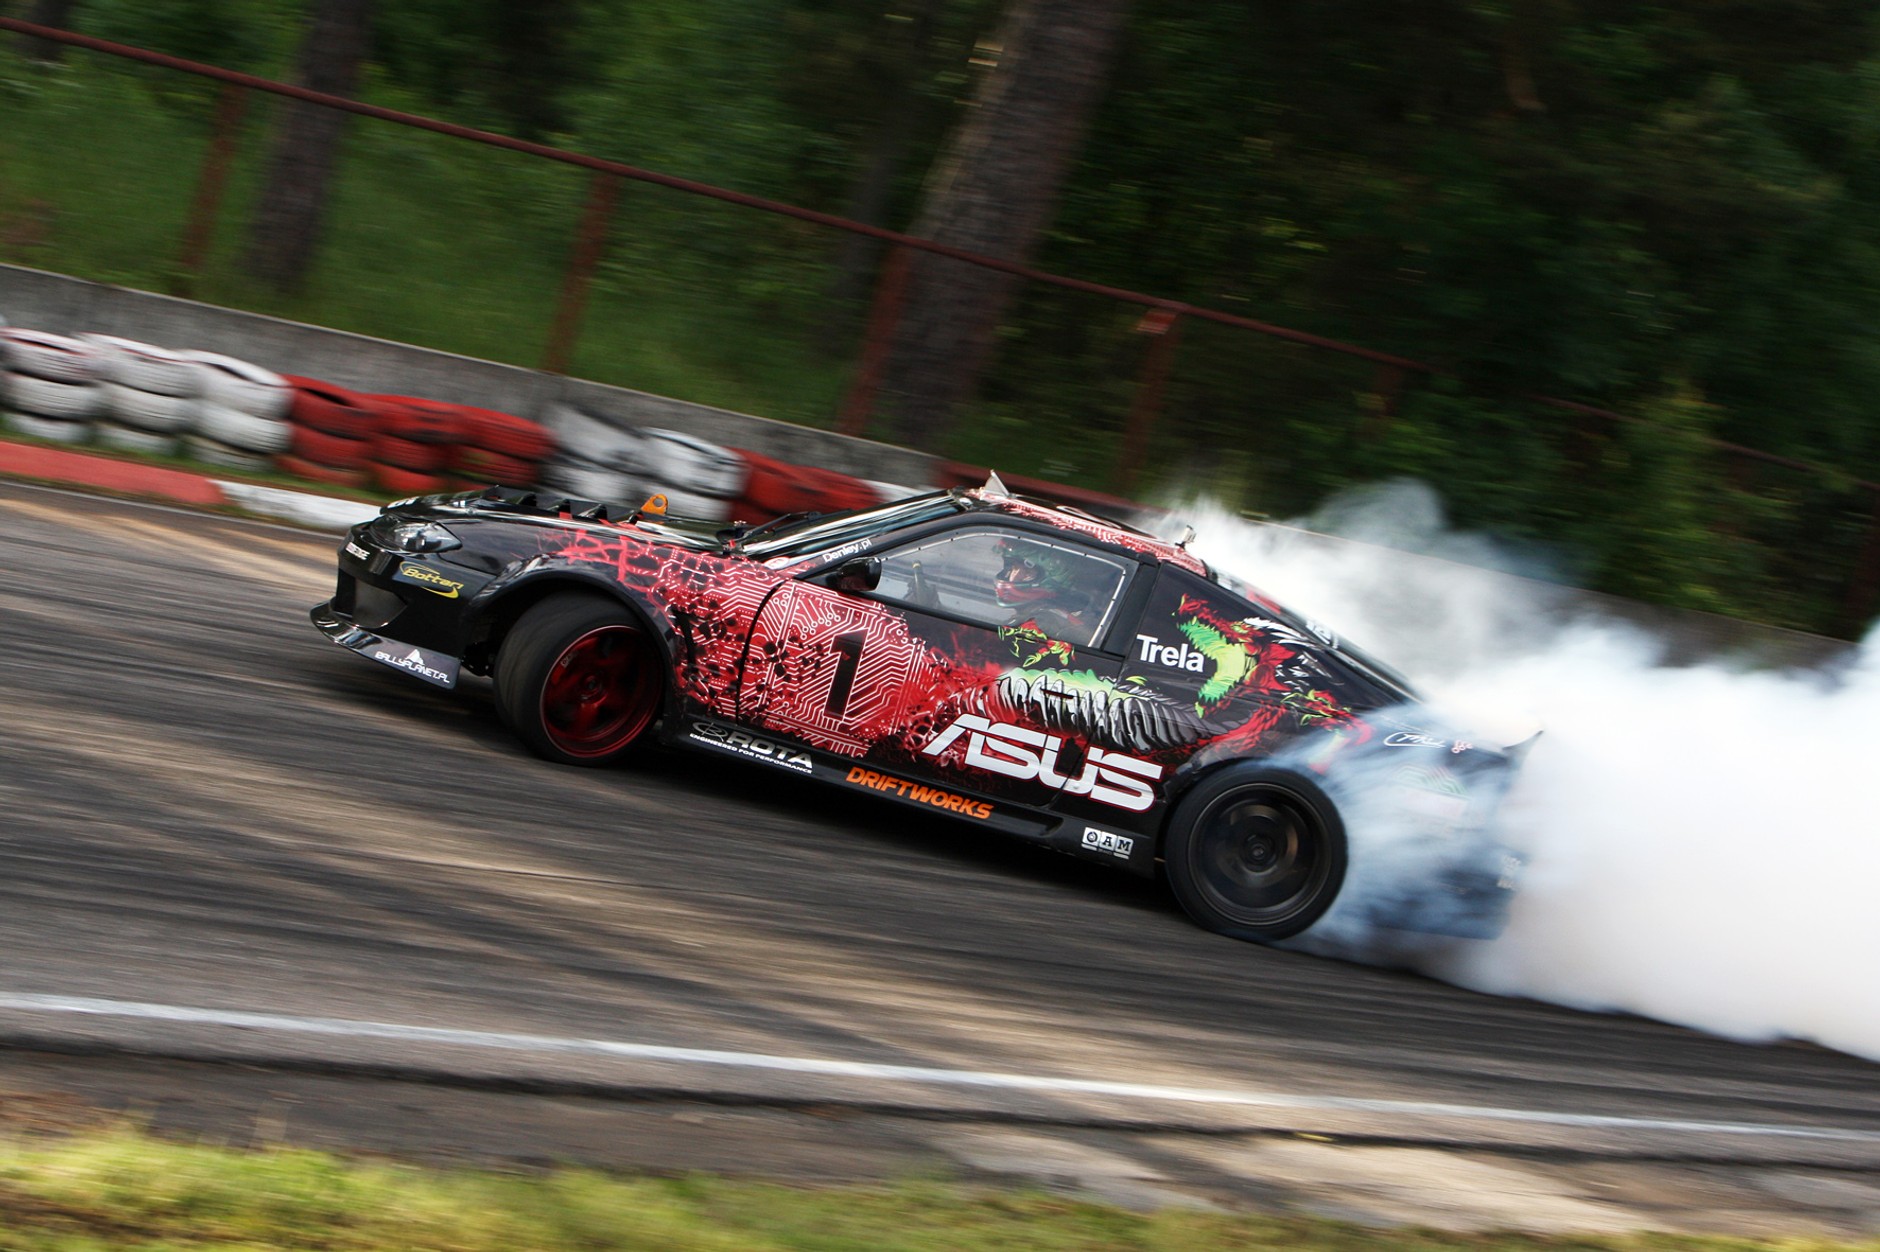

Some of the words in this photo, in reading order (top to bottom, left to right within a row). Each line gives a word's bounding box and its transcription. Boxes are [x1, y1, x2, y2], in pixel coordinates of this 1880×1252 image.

[822, 538, 873, 563] Denley.pl
[403, 567, 464, 590] Bottari
[1136, 633, 1205, 673] Trela
[823, 627, 870, 721] 1
[689, 733, 738, 752] ENGINEERED
[738, 748, 755, 758] FOR
[755, 753, 813, 774] PERFORMANCE
[726, 731, 813, 769] ROTA
[921, 713, 1164, 811] ASUS
[846, 766, 994, 820] DRIFTWORKS
